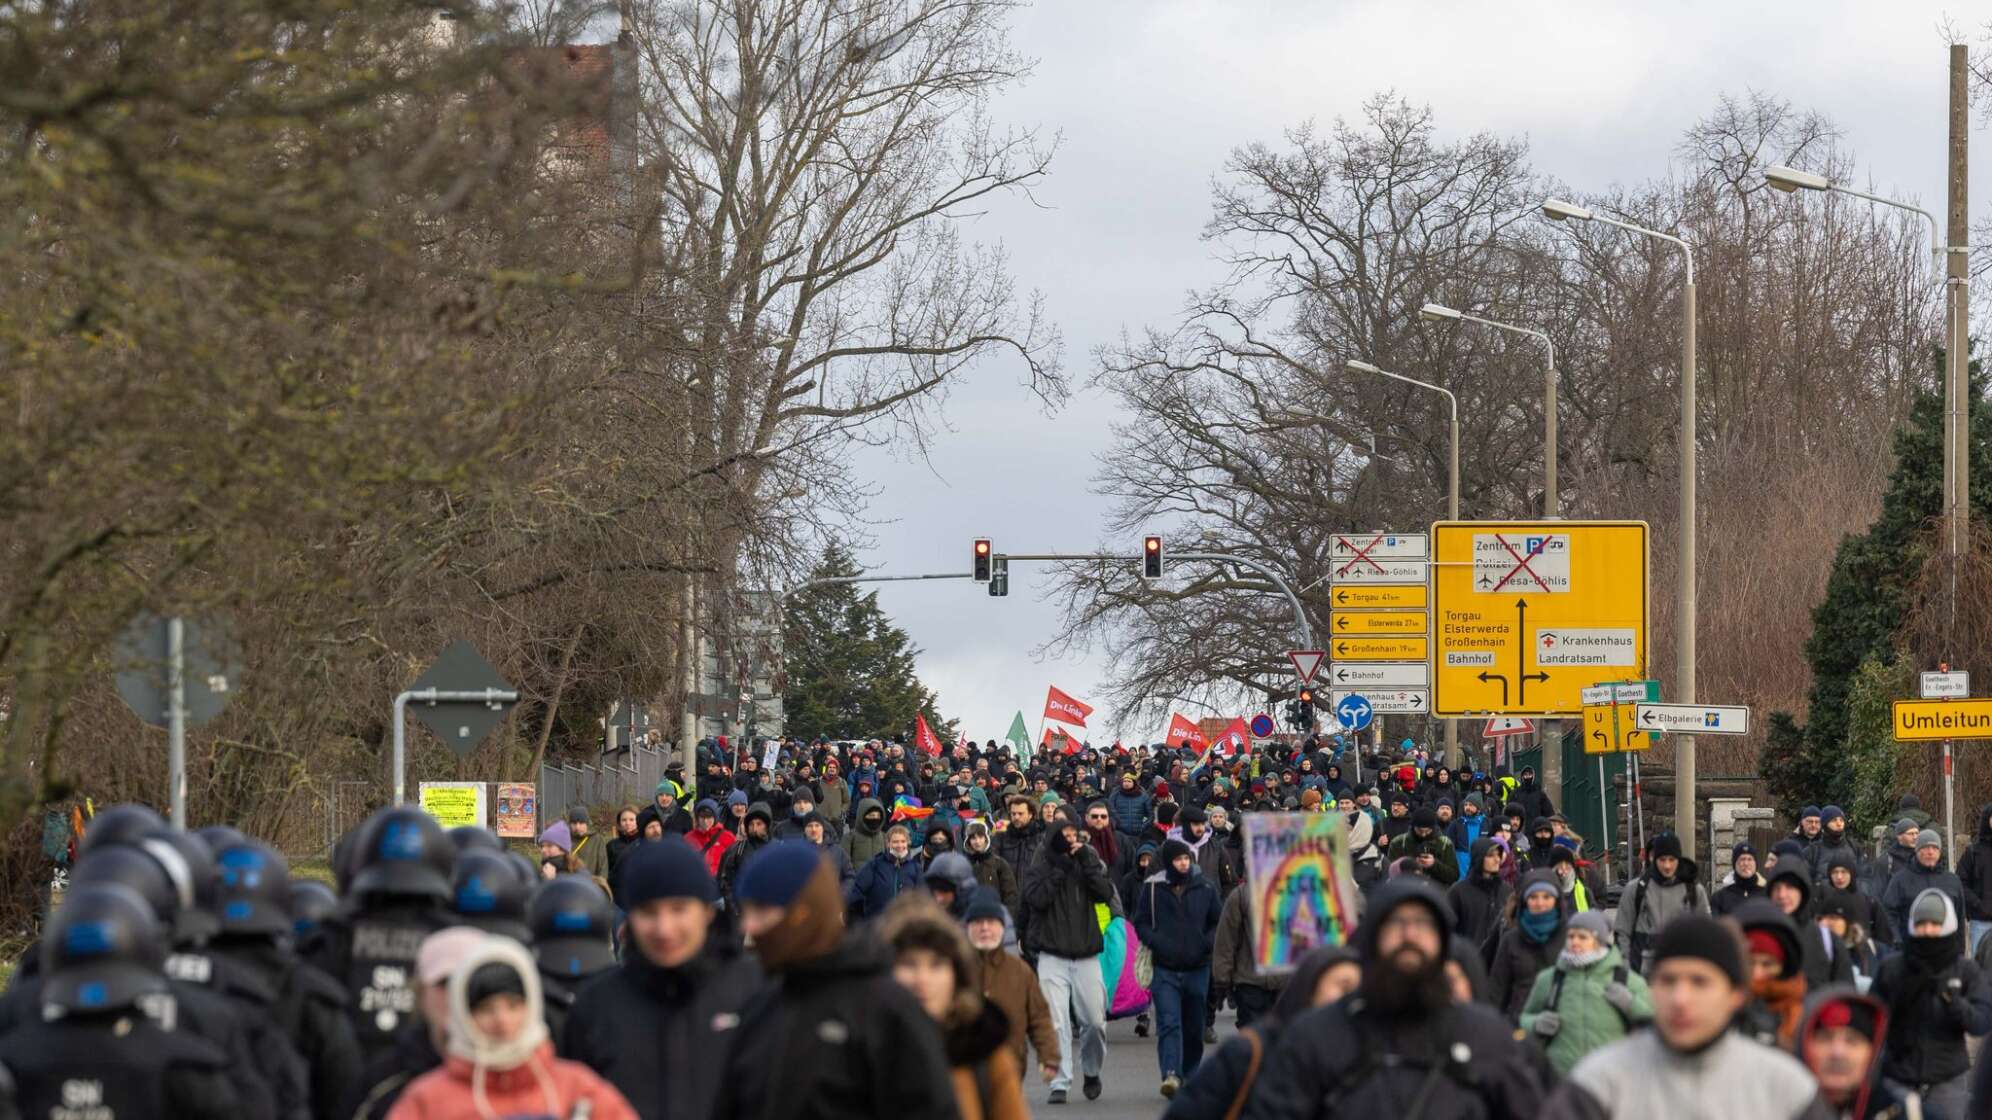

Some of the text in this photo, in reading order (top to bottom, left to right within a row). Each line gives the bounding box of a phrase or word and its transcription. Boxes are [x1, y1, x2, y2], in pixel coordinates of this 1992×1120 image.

[1476, 541, 1520, 551] Zentrum
[1352, 593, 1379, 602] Torgau
[1445, 610, 1481, 622] Torgau
[1444, 624, 1509, 633] Elsterwerda
[1444, 637, 1505, 647] Großenhain
[1562, 636, 1632, 646] Krankenhaus
[1351, 645, 1397, 653] Großenhain
[1448, 654, 1492, 664] Bahnhof
[1539, 654, 1606, 664] Landratsamt
[1594, 712, 1602, 723] U
[1658, 713, 1702, 724] Elbgalerie
